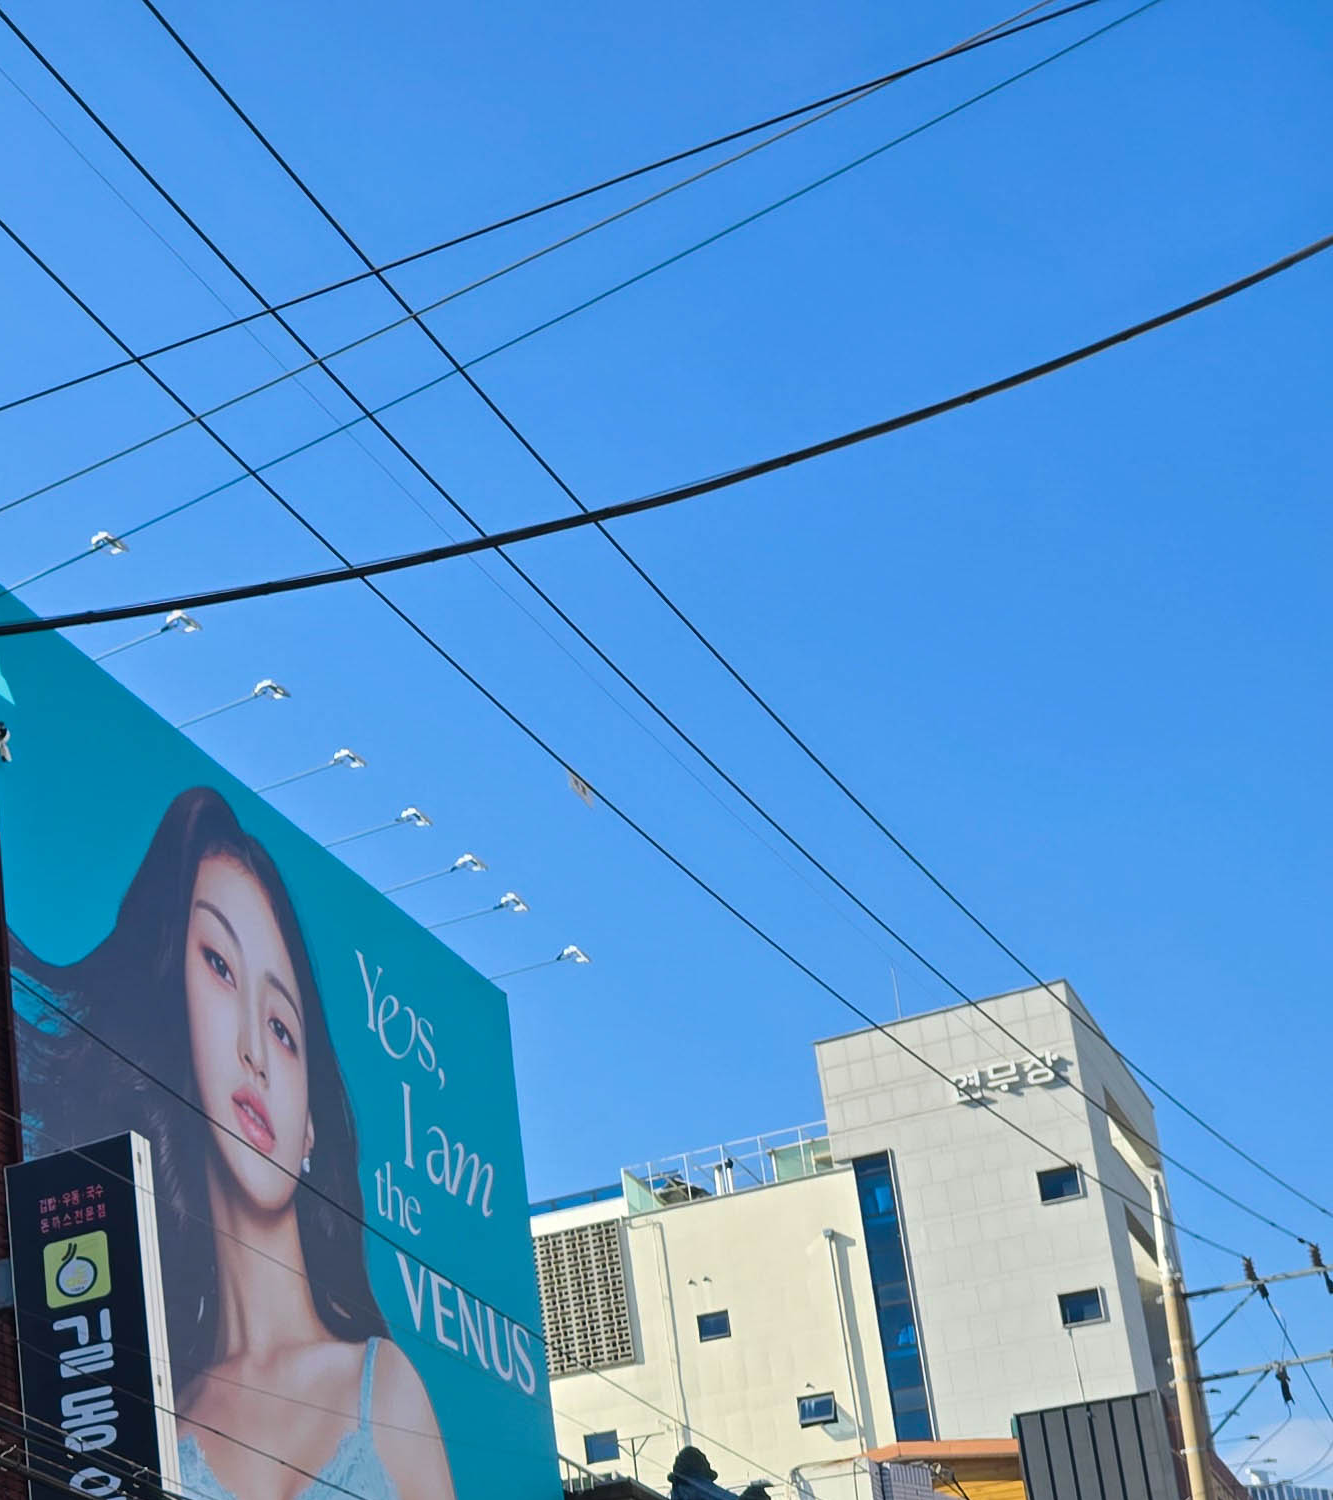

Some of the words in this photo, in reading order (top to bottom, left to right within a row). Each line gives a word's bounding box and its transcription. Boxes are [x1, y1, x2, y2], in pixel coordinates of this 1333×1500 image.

[355, 949, 445, 1090] Yes,
[374, 1161, 422, 1236] the
[401, 1080, 414, 1169] I
[426, 1125, 494, 1219] am
[395, 1251, 536, 1396] VENUS
